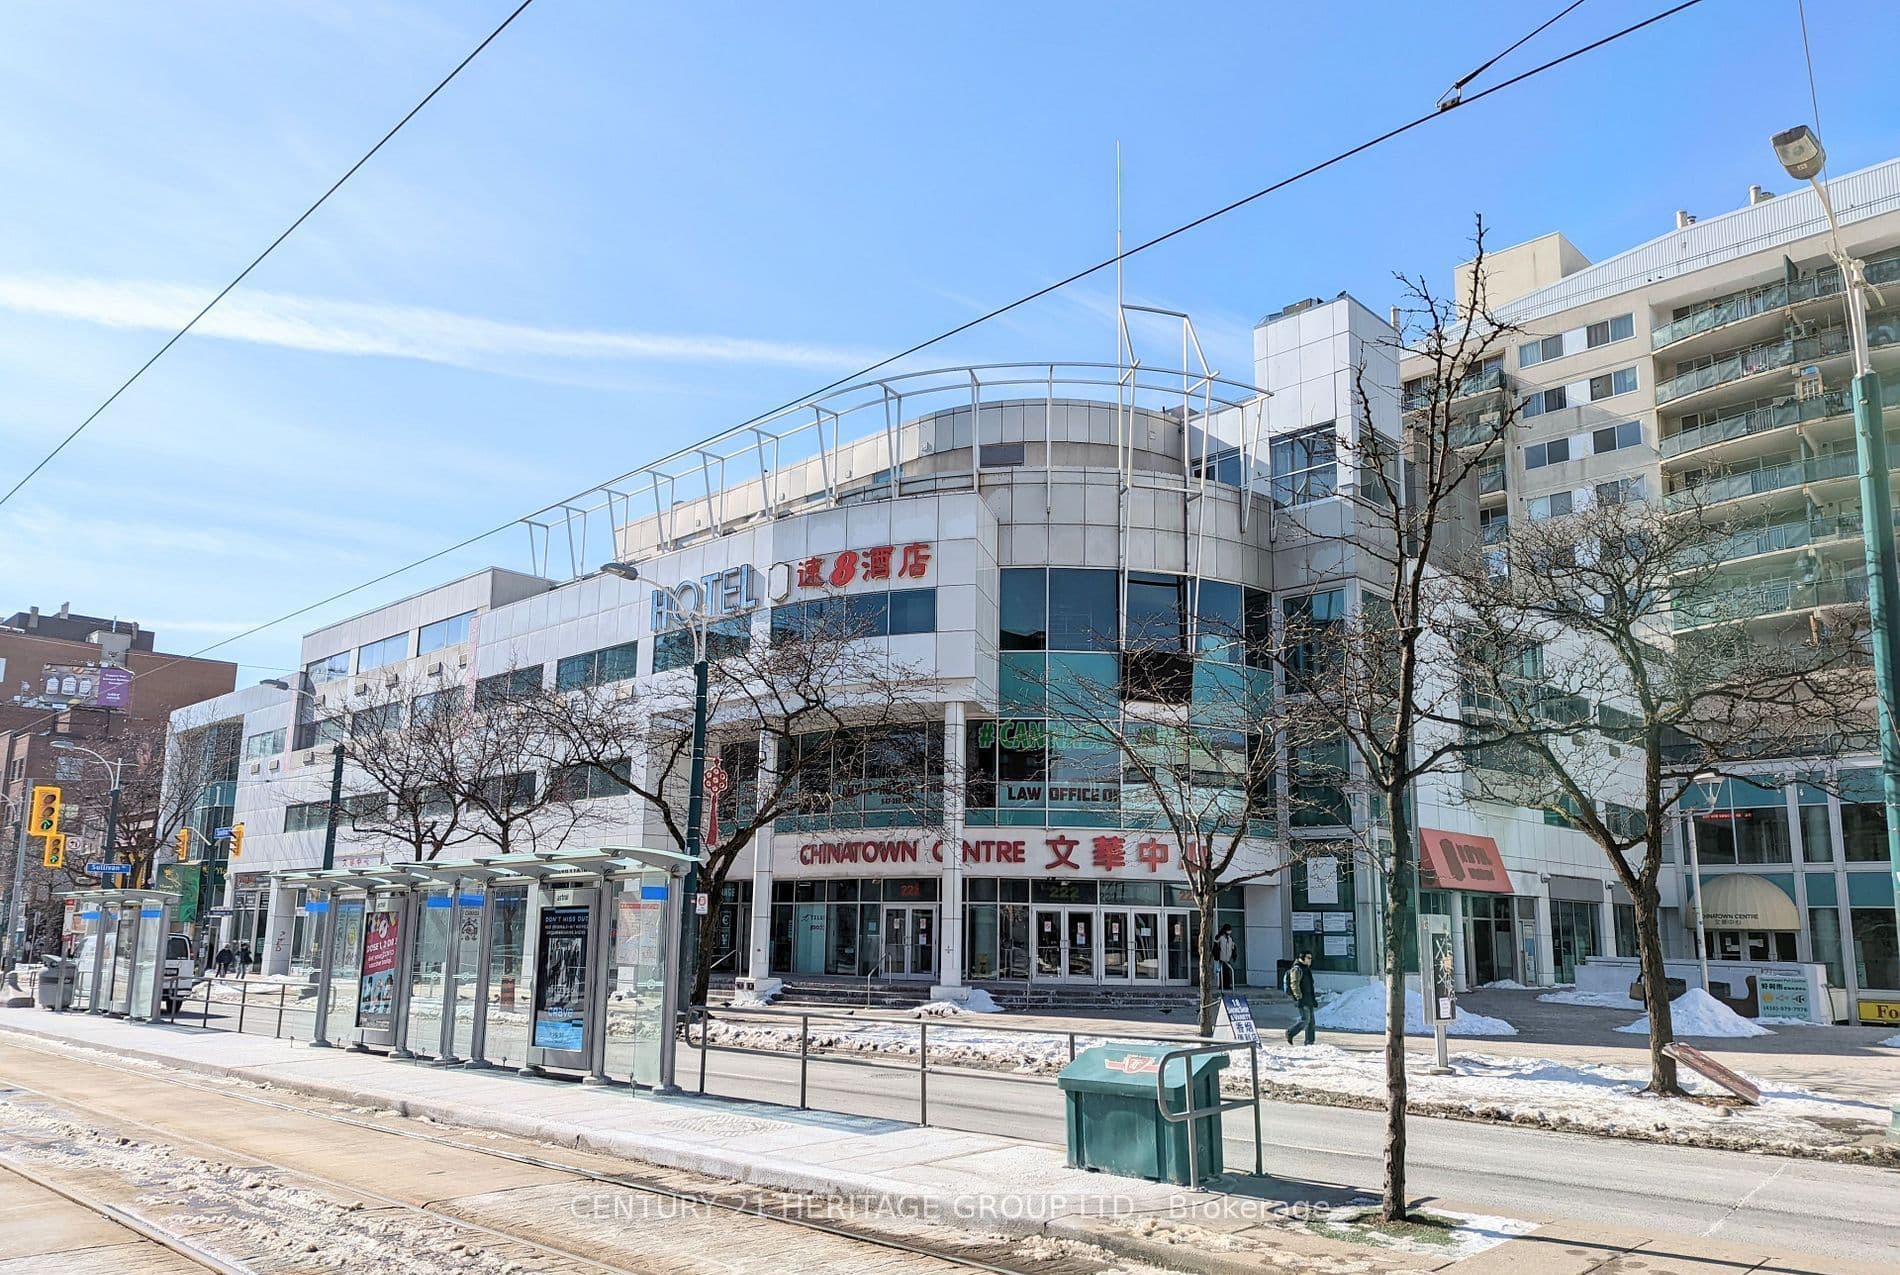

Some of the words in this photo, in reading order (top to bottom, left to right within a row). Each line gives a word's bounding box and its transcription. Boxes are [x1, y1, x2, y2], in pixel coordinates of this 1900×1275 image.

[797, 541, 932, 589] 速8酒店
[650, 563, 757, 632] HOTEL
[1007, 787, 1042, 801] LAW
[1049, 787, 1100, 802] OFFICE
[799, 839, 918, 866] CHINATOWN
[931, 839, 1026, 864] CNTRE
[90, 863, 121, 872] Sullivan
[1050, 887, 1080, 899] 222
